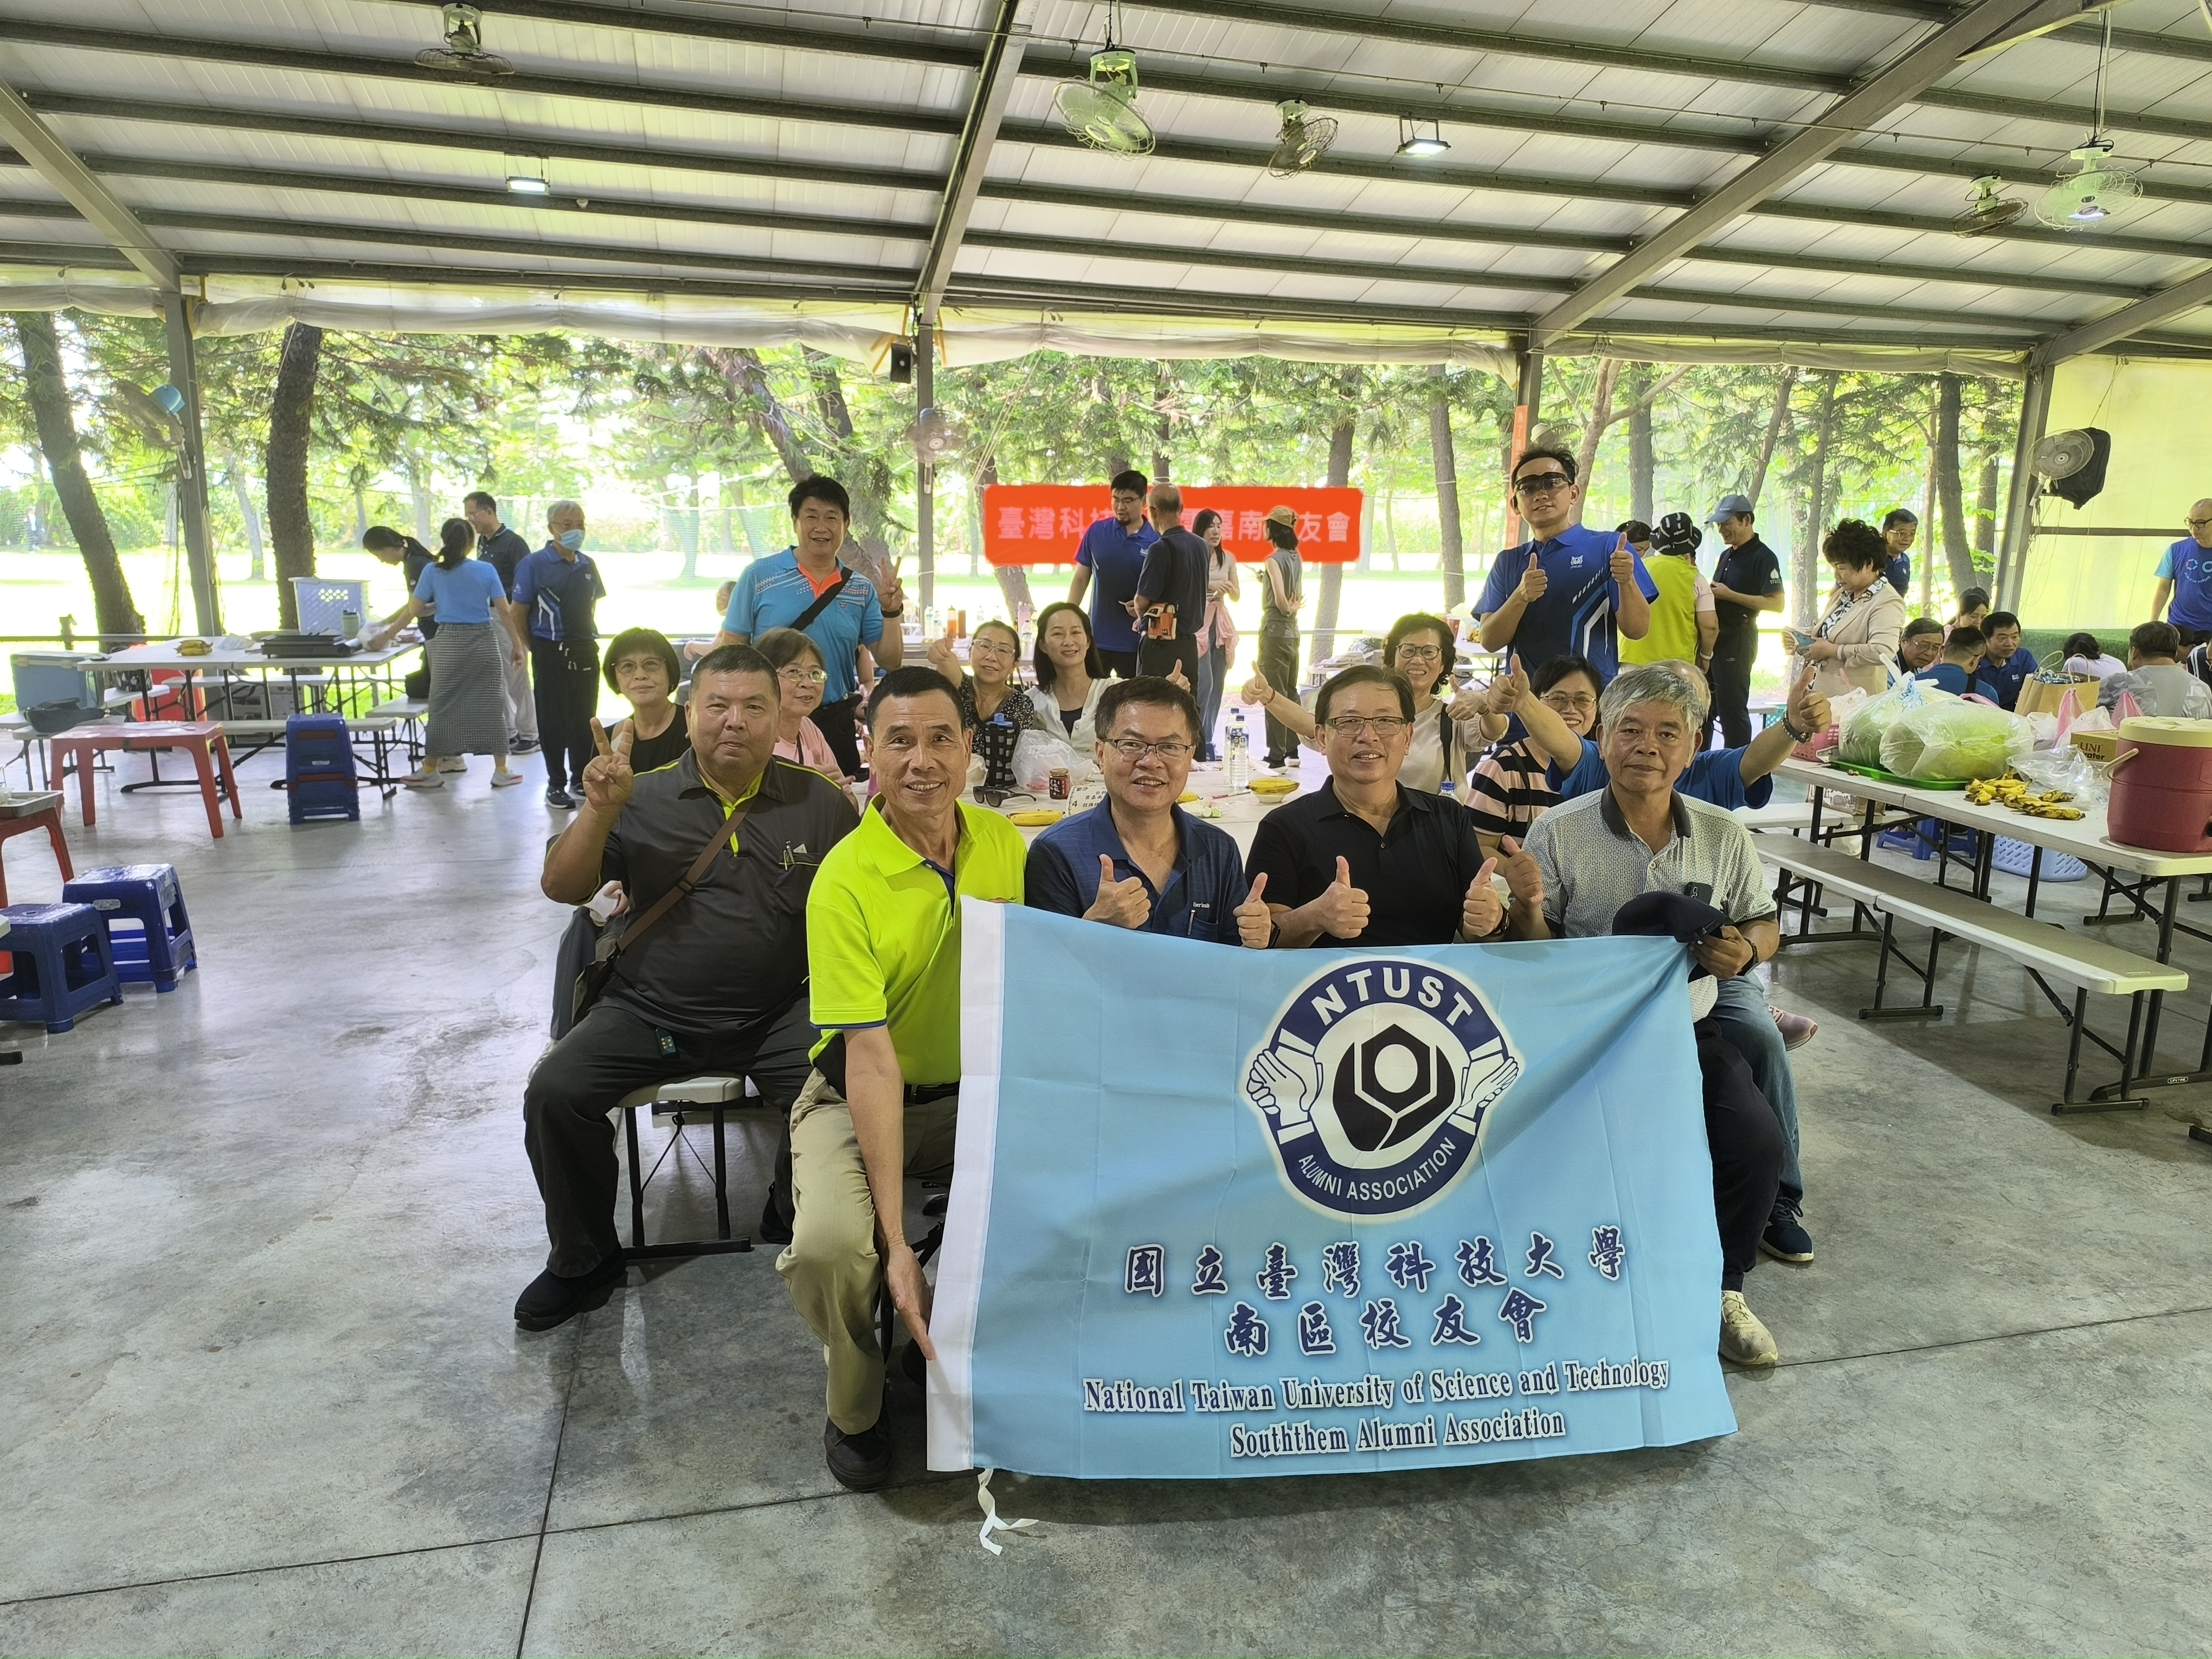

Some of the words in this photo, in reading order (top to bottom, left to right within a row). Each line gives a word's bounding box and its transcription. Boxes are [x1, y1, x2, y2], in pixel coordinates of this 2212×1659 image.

[1310, 967, 1474, 1026] NTUST
[1298, 1154, 1342, 1197] ALUMNI
[1346, 1136, 1457, 1201] ASSOCIATION
[1126, 1226, 1625, 1298] 國立臺灣科技大學
[1225, 1287, 1544, 1356] 南區校友會
[1084, 1380, 1184, 1410] National
[1192, 1381, 1274, 1410] Taiwan
[1282, 1377, 1393, 1408] University
[1402, 1373, 1424, 1401] of
[1431, 1370, 1511, 1400] Science
[1520, 1364, 1558, 1393] and
[1564, 1357, 1669, 1388] Technology
[1232, 1421, 1348, 1456] Souththem
[1357, 1418, 1436, 1450] Alumni
[1444, 1411, 1565, 1445] Association
